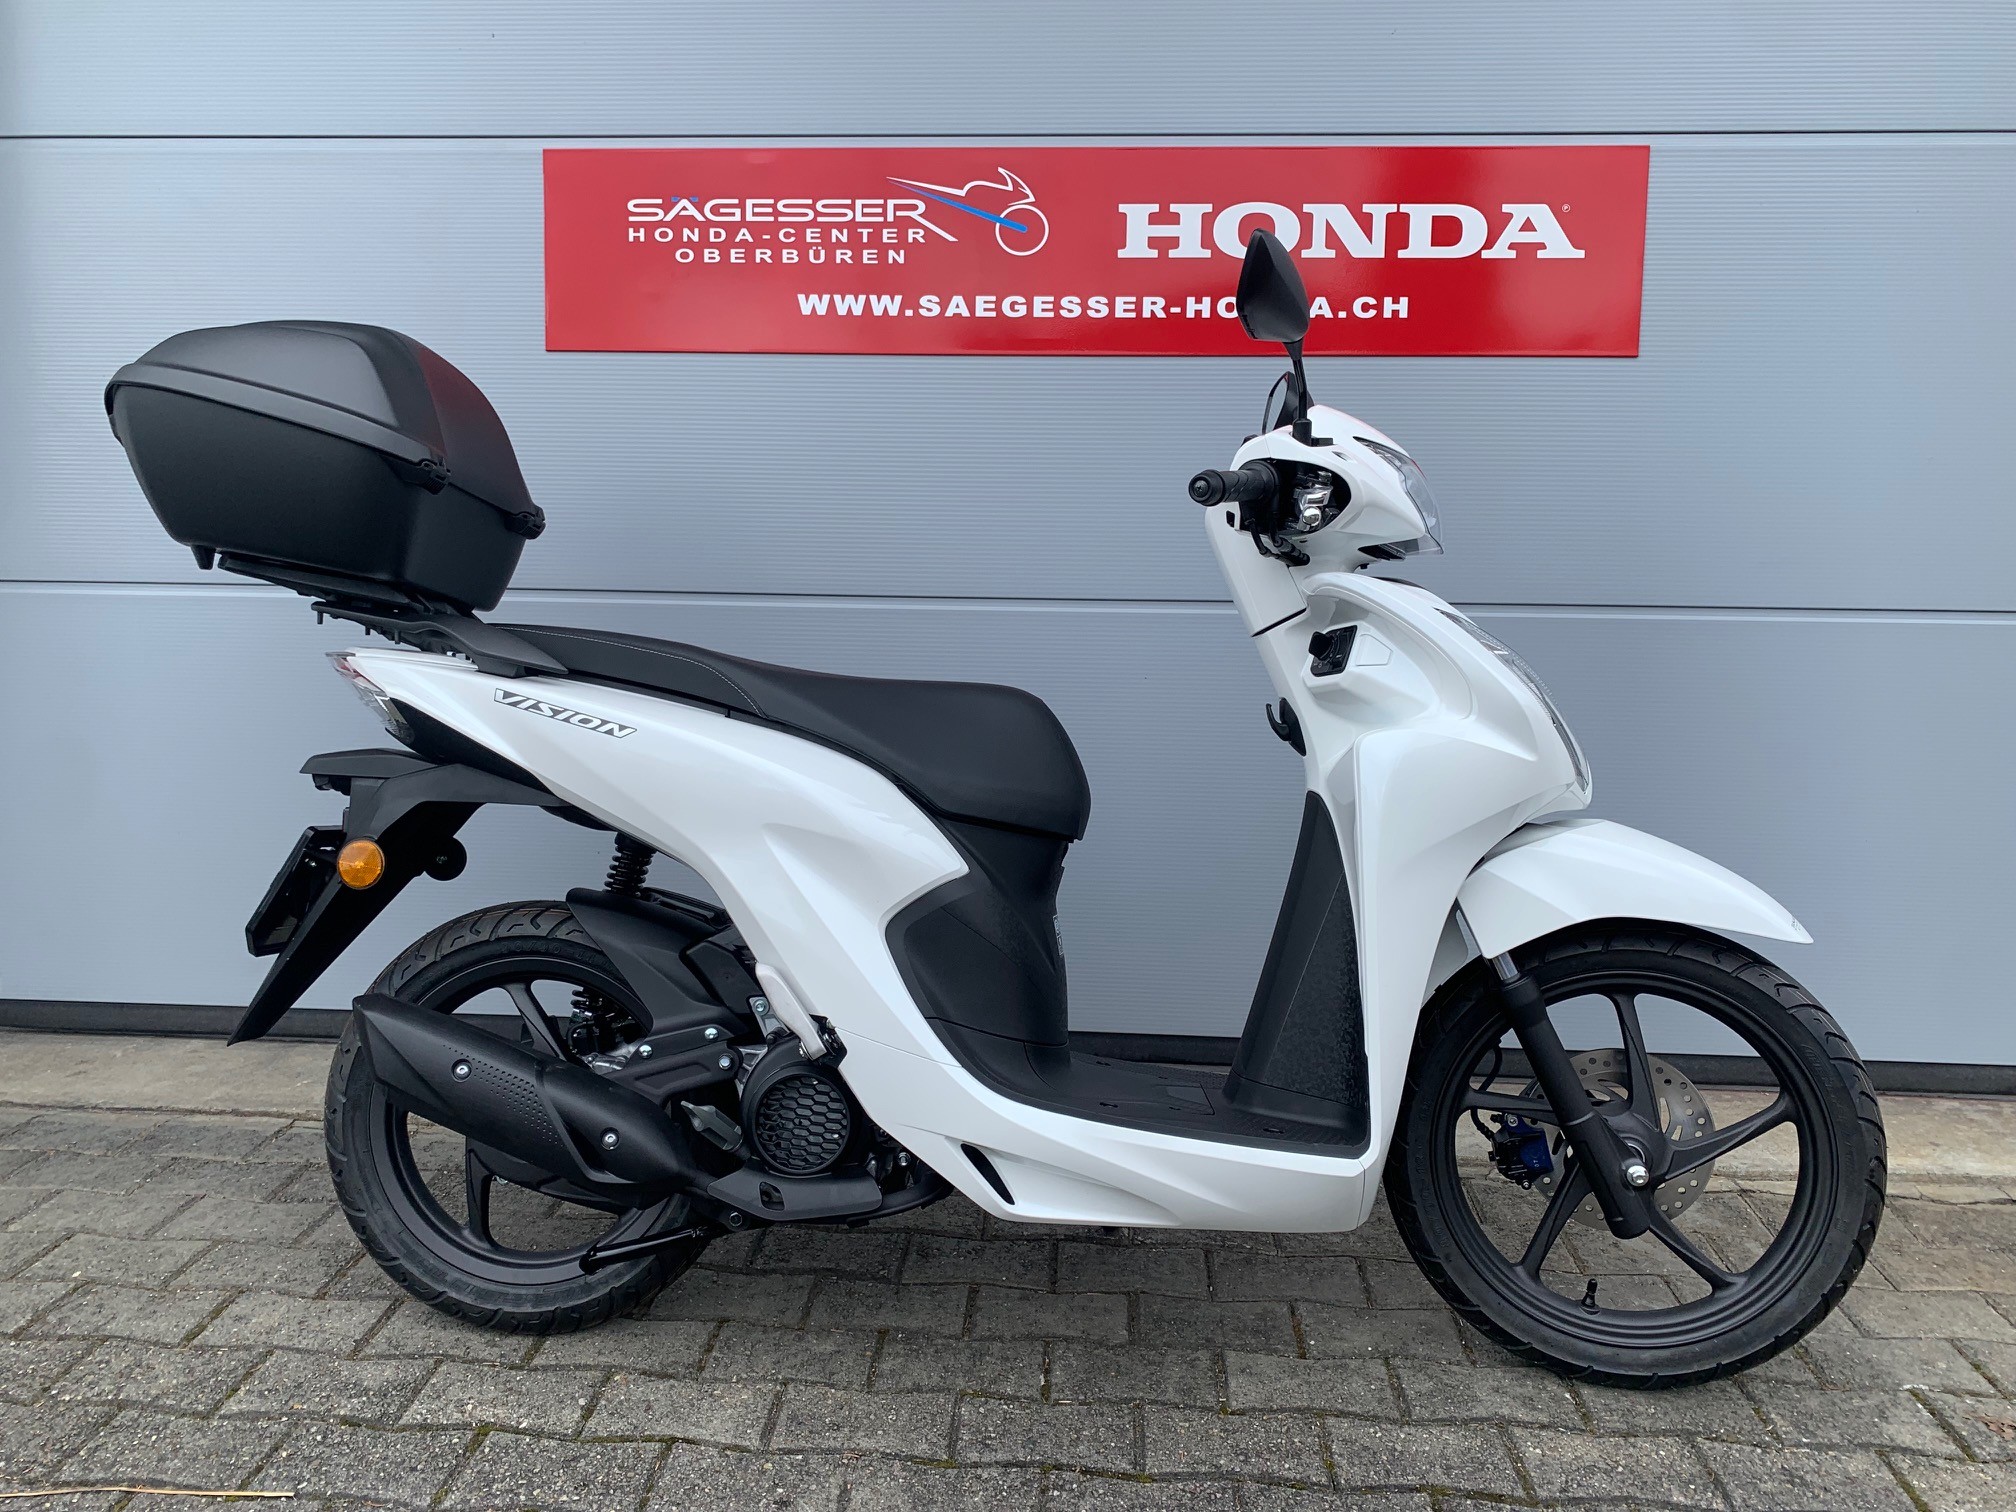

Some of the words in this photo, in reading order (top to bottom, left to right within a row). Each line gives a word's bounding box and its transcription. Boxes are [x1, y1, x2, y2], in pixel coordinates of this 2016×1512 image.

[627, 196, 958, 242] SÄGESSER
[628, 226, 926, 243] HONDA-CENTER
[1117, 201, 1586, 259] HONDA
[675, 246, 905, 264] OBERBÜREN
[797, 293, 1409, 319] WWW.SAEGESSER-HOA.CH
[494, 688, 637, 738] VISION
